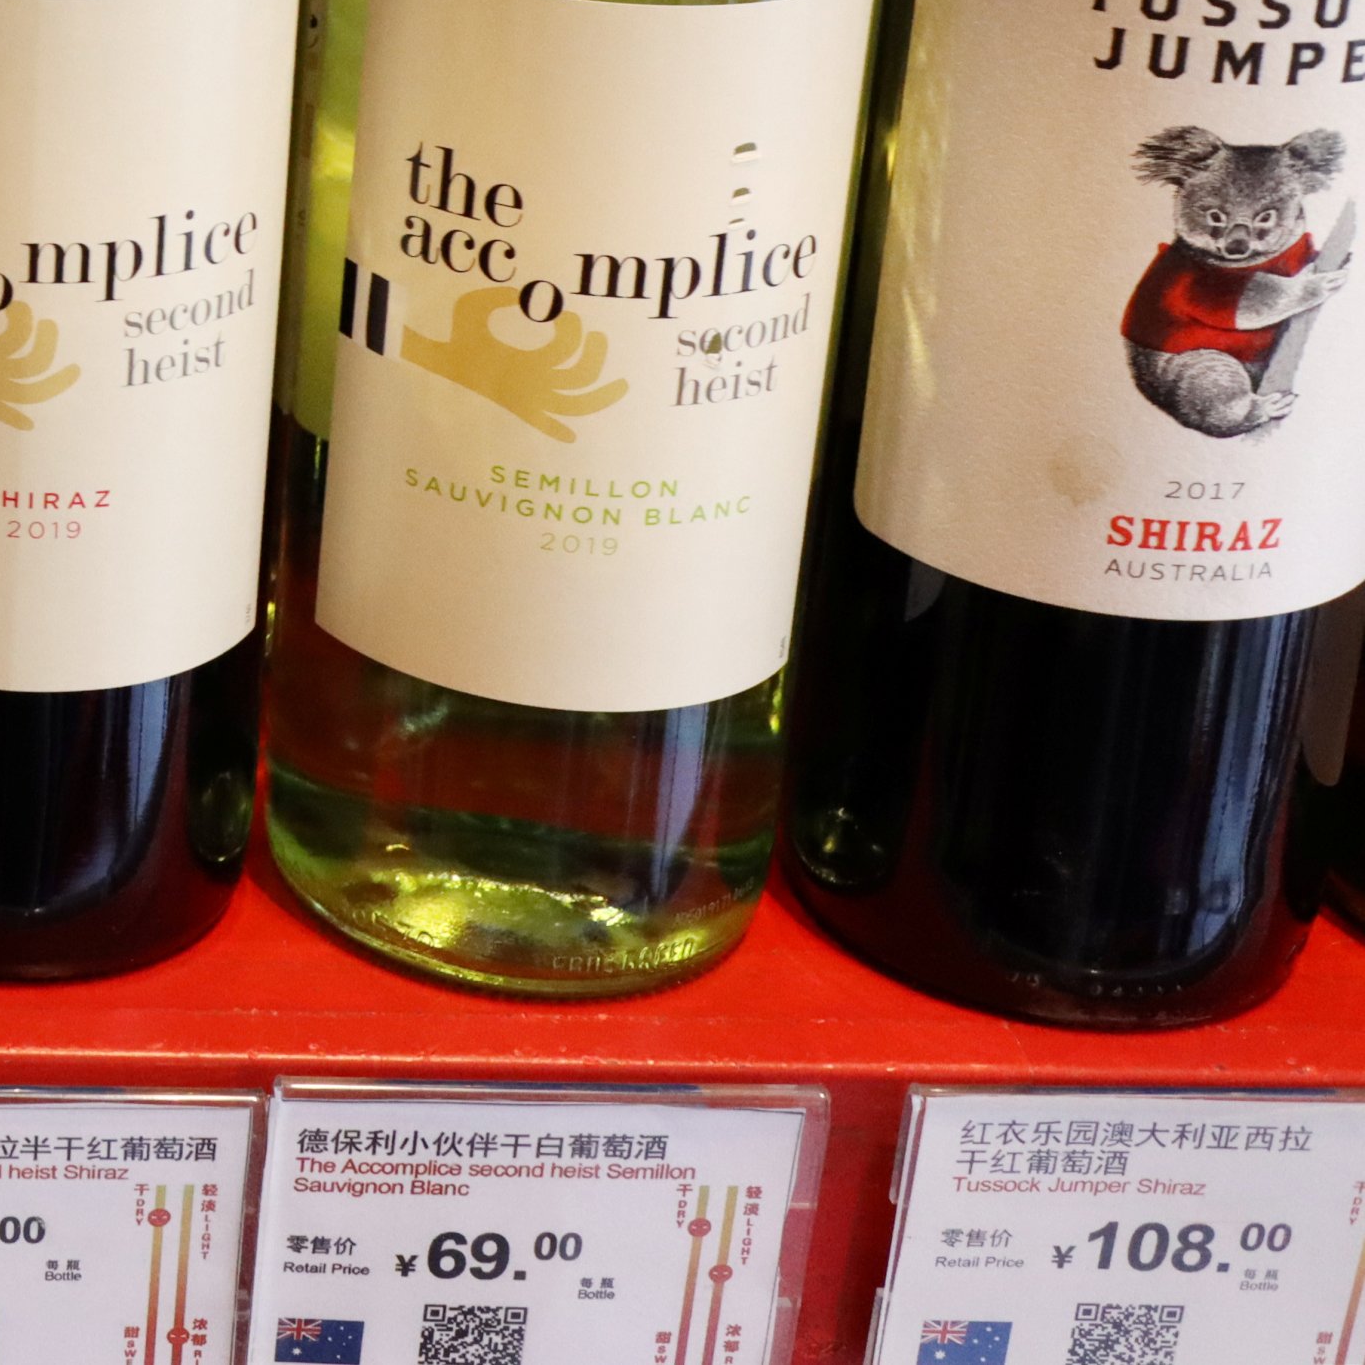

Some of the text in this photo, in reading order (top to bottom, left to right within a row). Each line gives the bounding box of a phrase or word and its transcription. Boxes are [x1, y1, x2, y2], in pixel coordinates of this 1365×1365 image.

[406, 141, 524, 228] the
[123, 270, 257, 340] second
[675, 292, 812, 359] second
[121, 330, 227, 388] heist
[671, 355, 778, 408] heist
[405, 468, 752, 526] SAUVIGNON BLANC
[491, 464, 679, 498] SEMILLON
[1164, 480, 1245, 501] 2017
[6, 521, 82, 541] 2019
[539, 531, 619, 557] 2019
[1106, 515, 1283, 552] SHIRAZ
[1104, 558, 1273, 581] AUSTRALIA
[297, 1128, 667, 1161] 德保利小伙伴干白葡萄酒
[960, 1119, 1314, 1153] 红衣乐园澳大利亚西拉
[8, 1163, 58, 1181] heist
[63, 1163, 129, 1181] Shiraz
[295, 1157, 695, 1181] The Accomplice second heist Semillon
[956, 1150, 1128, 1177] 干红葡萄酒
[293, 1177, 470, 1198] Sauvignon Blanc
[952, 1176, 1207, 1198] Tussock Jumper Shiraz
